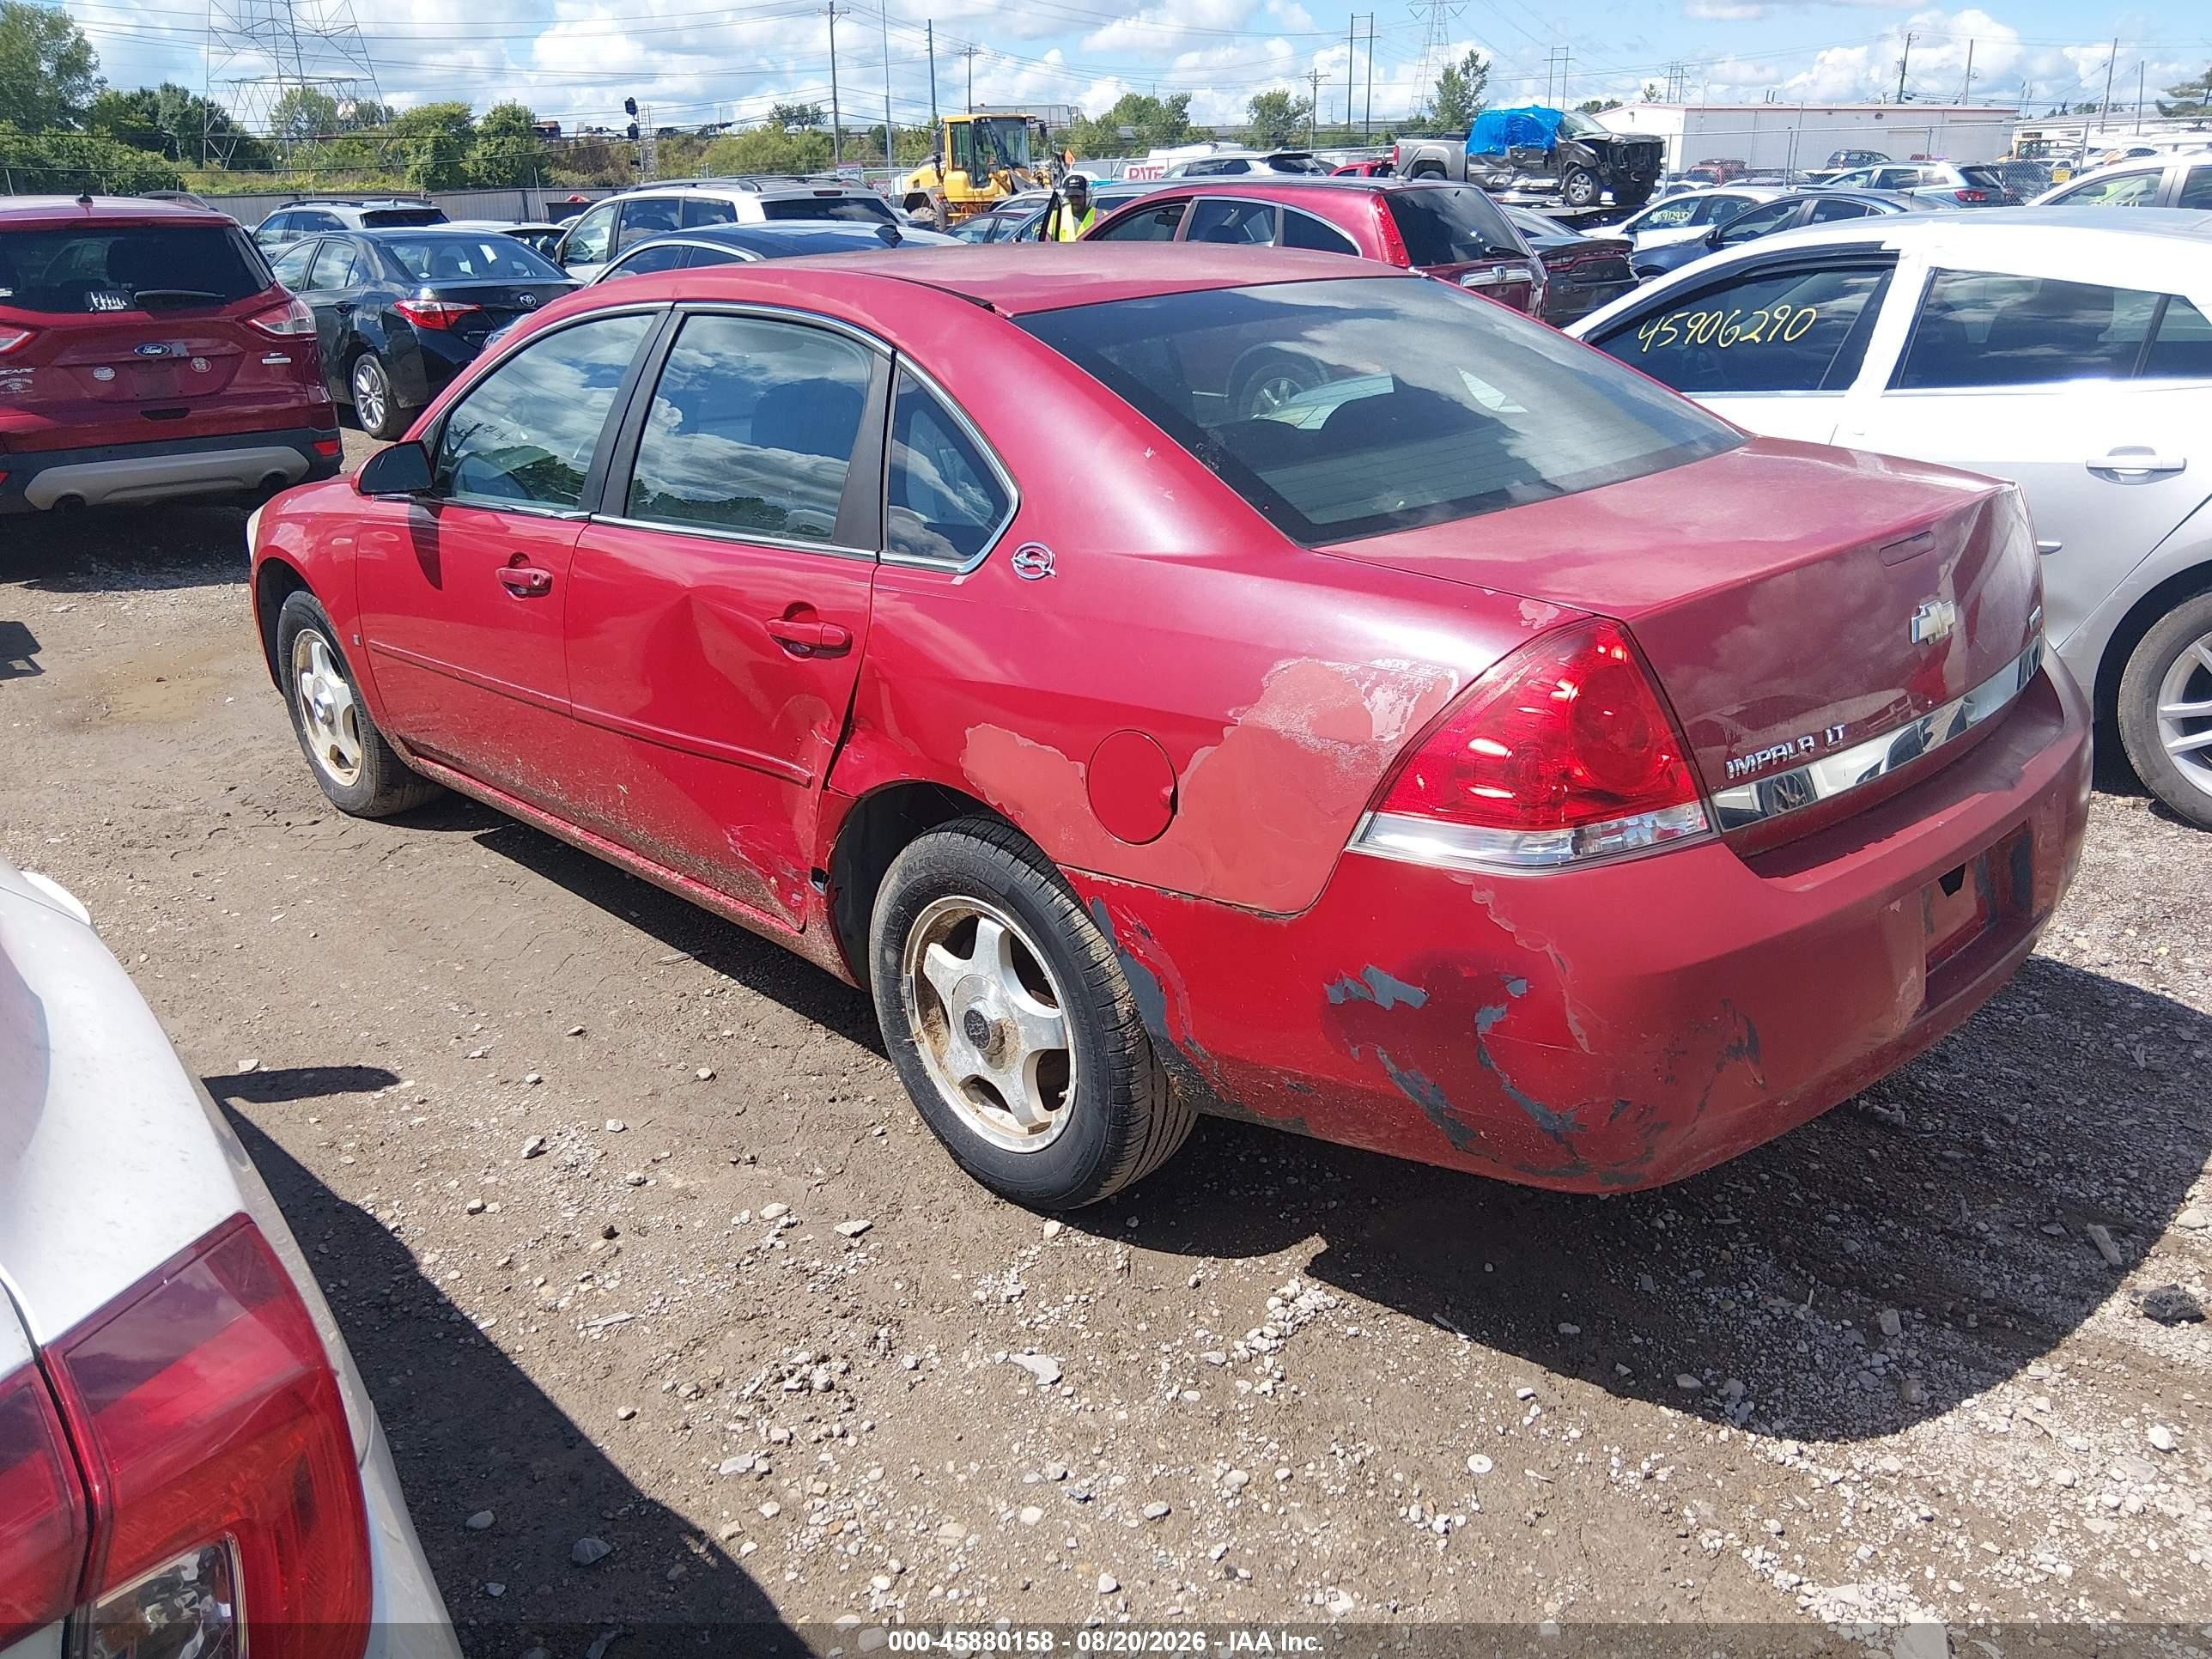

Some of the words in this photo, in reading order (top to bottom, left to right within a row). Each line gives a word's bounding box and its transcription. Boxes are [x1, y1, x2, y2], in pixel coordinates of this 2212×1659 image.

[1638, 304, 1817, 353] 45906290
[1725, 735, 1815, 780] IMPALA
[1822, 723, 1846, 747] LT
